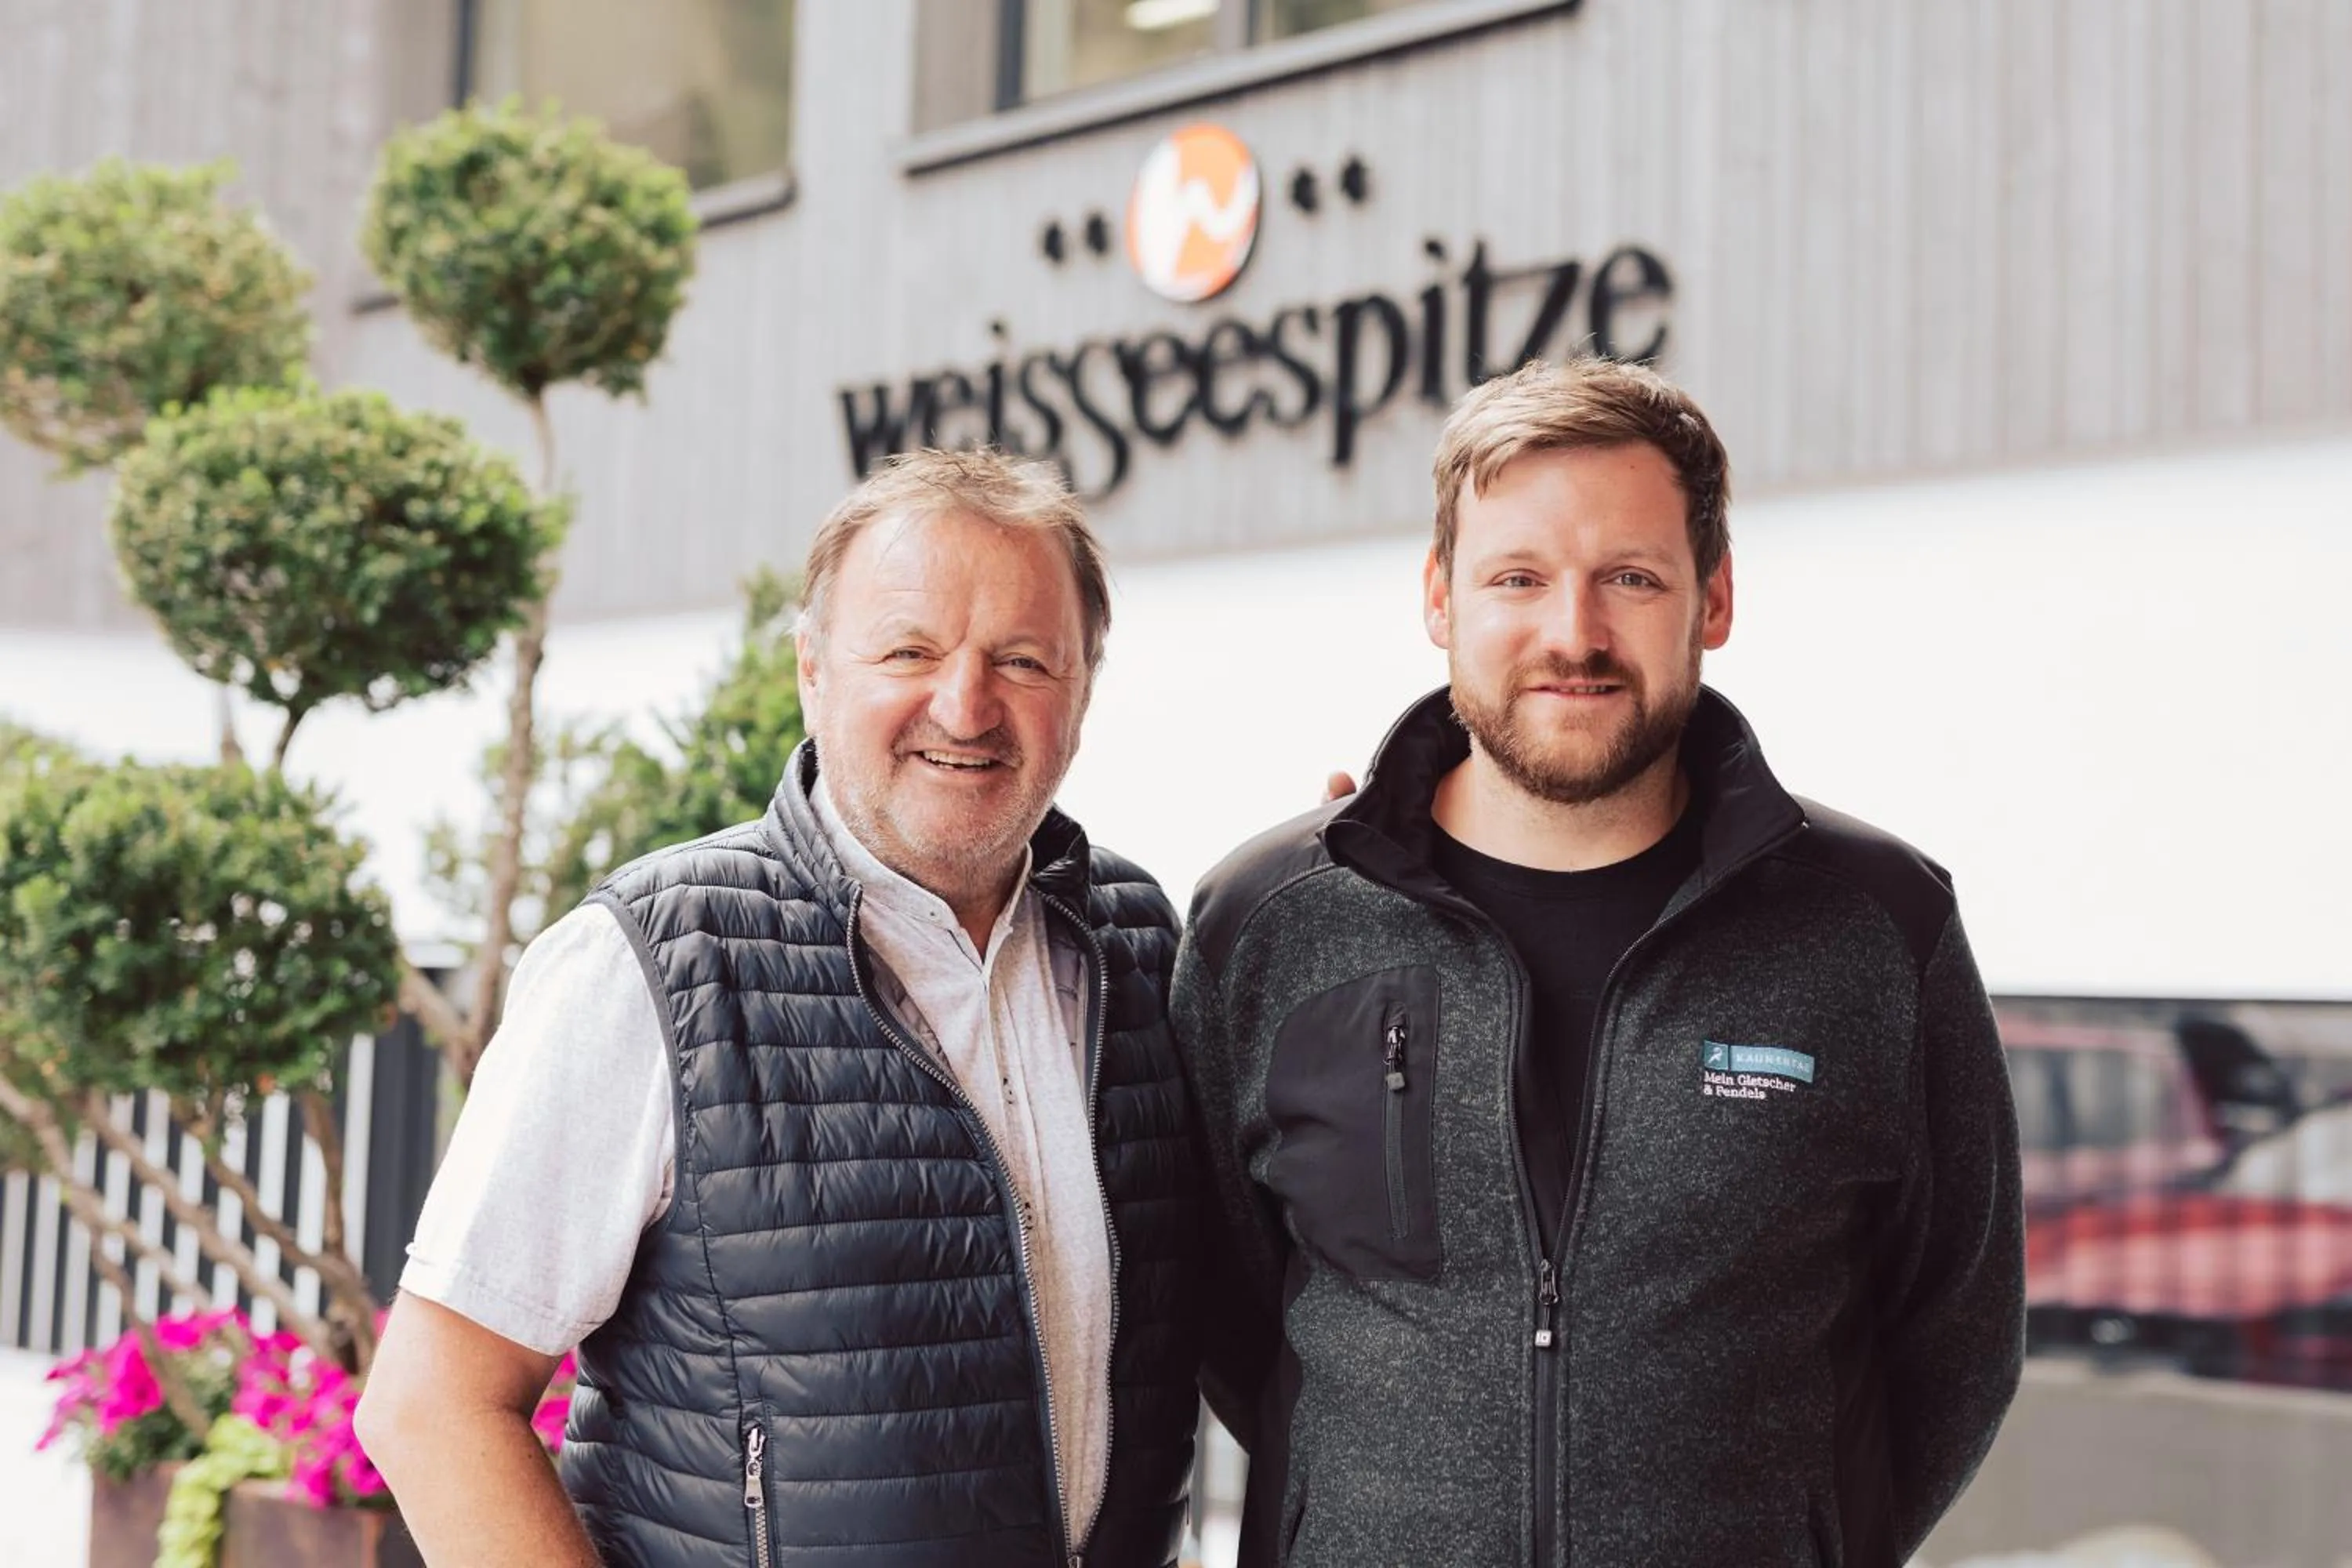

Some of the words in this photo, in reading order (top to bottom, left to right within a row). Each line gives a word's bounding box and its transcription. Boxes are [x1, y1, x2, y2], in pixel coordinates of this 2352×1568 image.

[837, 238, 1673, 503] weisseespitze
[1704, 1071, 1733, 1086] Mein
[1704, 1084, 1713, 1095] &
